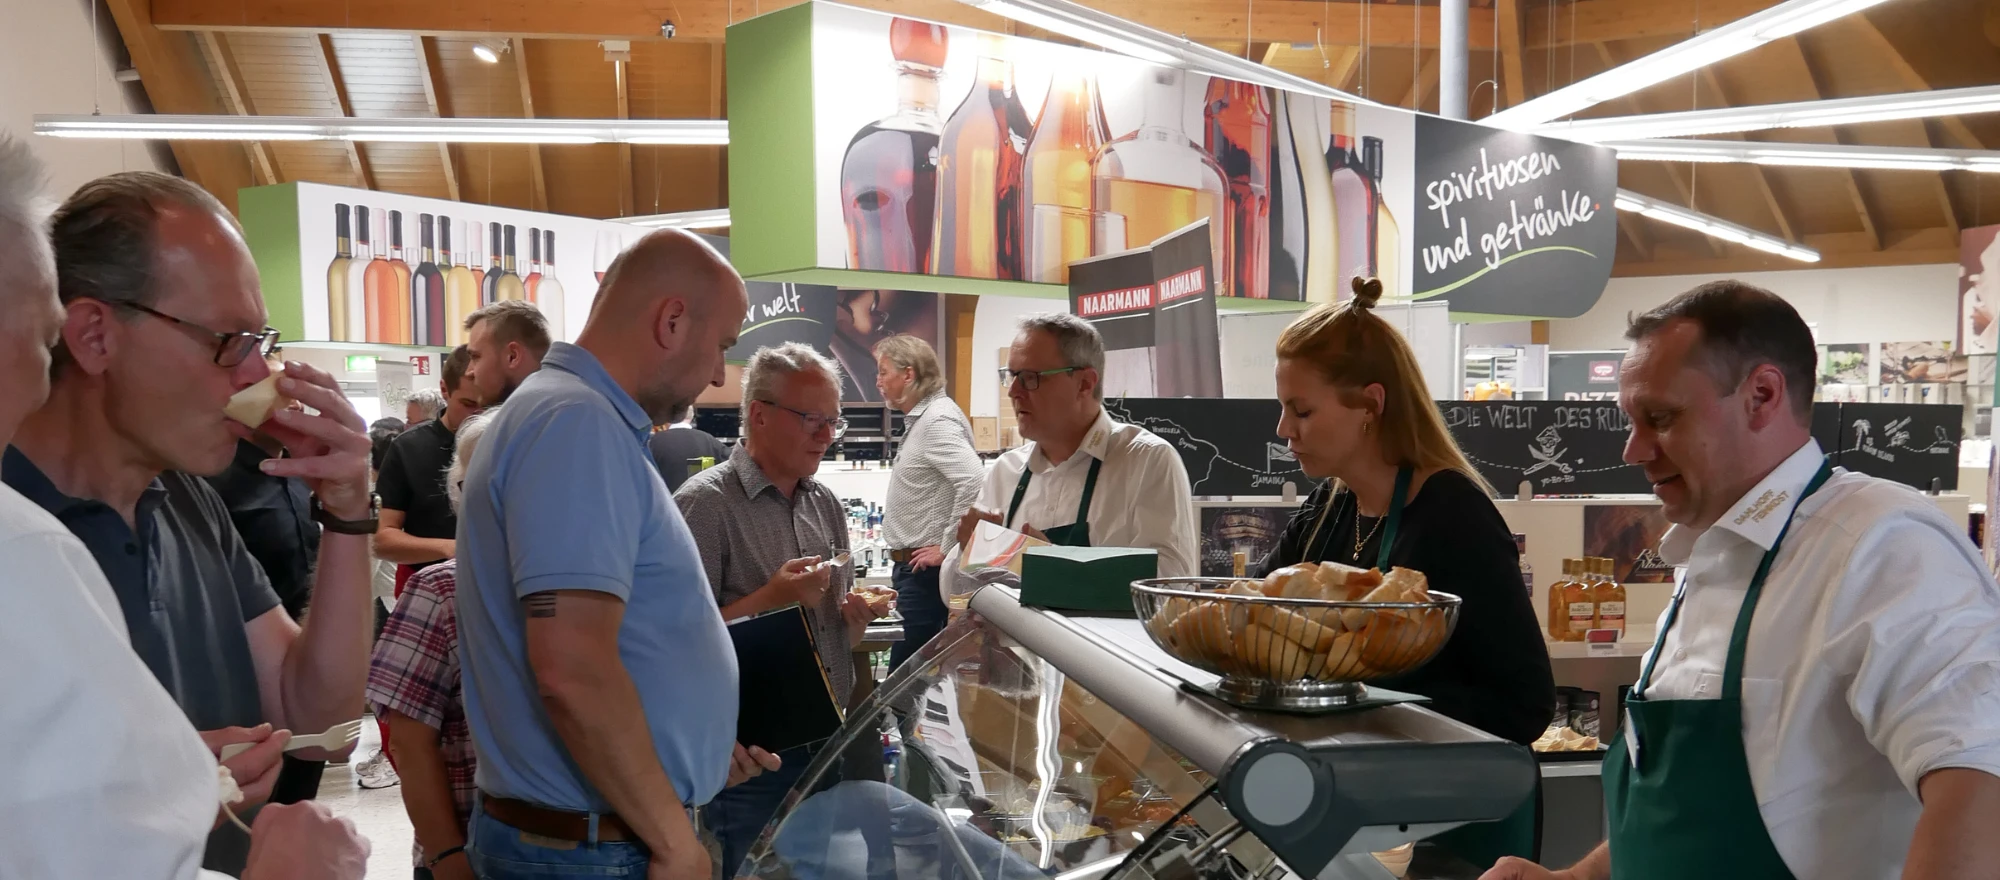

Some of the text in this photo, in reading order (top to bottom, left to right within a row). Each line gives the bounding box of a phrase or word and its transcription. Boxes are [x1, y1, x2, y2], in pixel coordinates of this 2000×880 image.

[1426, 147, 1561, 229] spirituosen
[1422, 217, 1472, 274] und
[1159, 269, 1203, 301] NAARMANN
[1083, 287, 1151, 315] NAARMANN
[1449, 406, 1481, 428] DIE
[1486, 404, 1538, 430] WELT
[1553, 406, 1591, 430] DES
[1251, 474, 1286, 488] JAMAIKA
